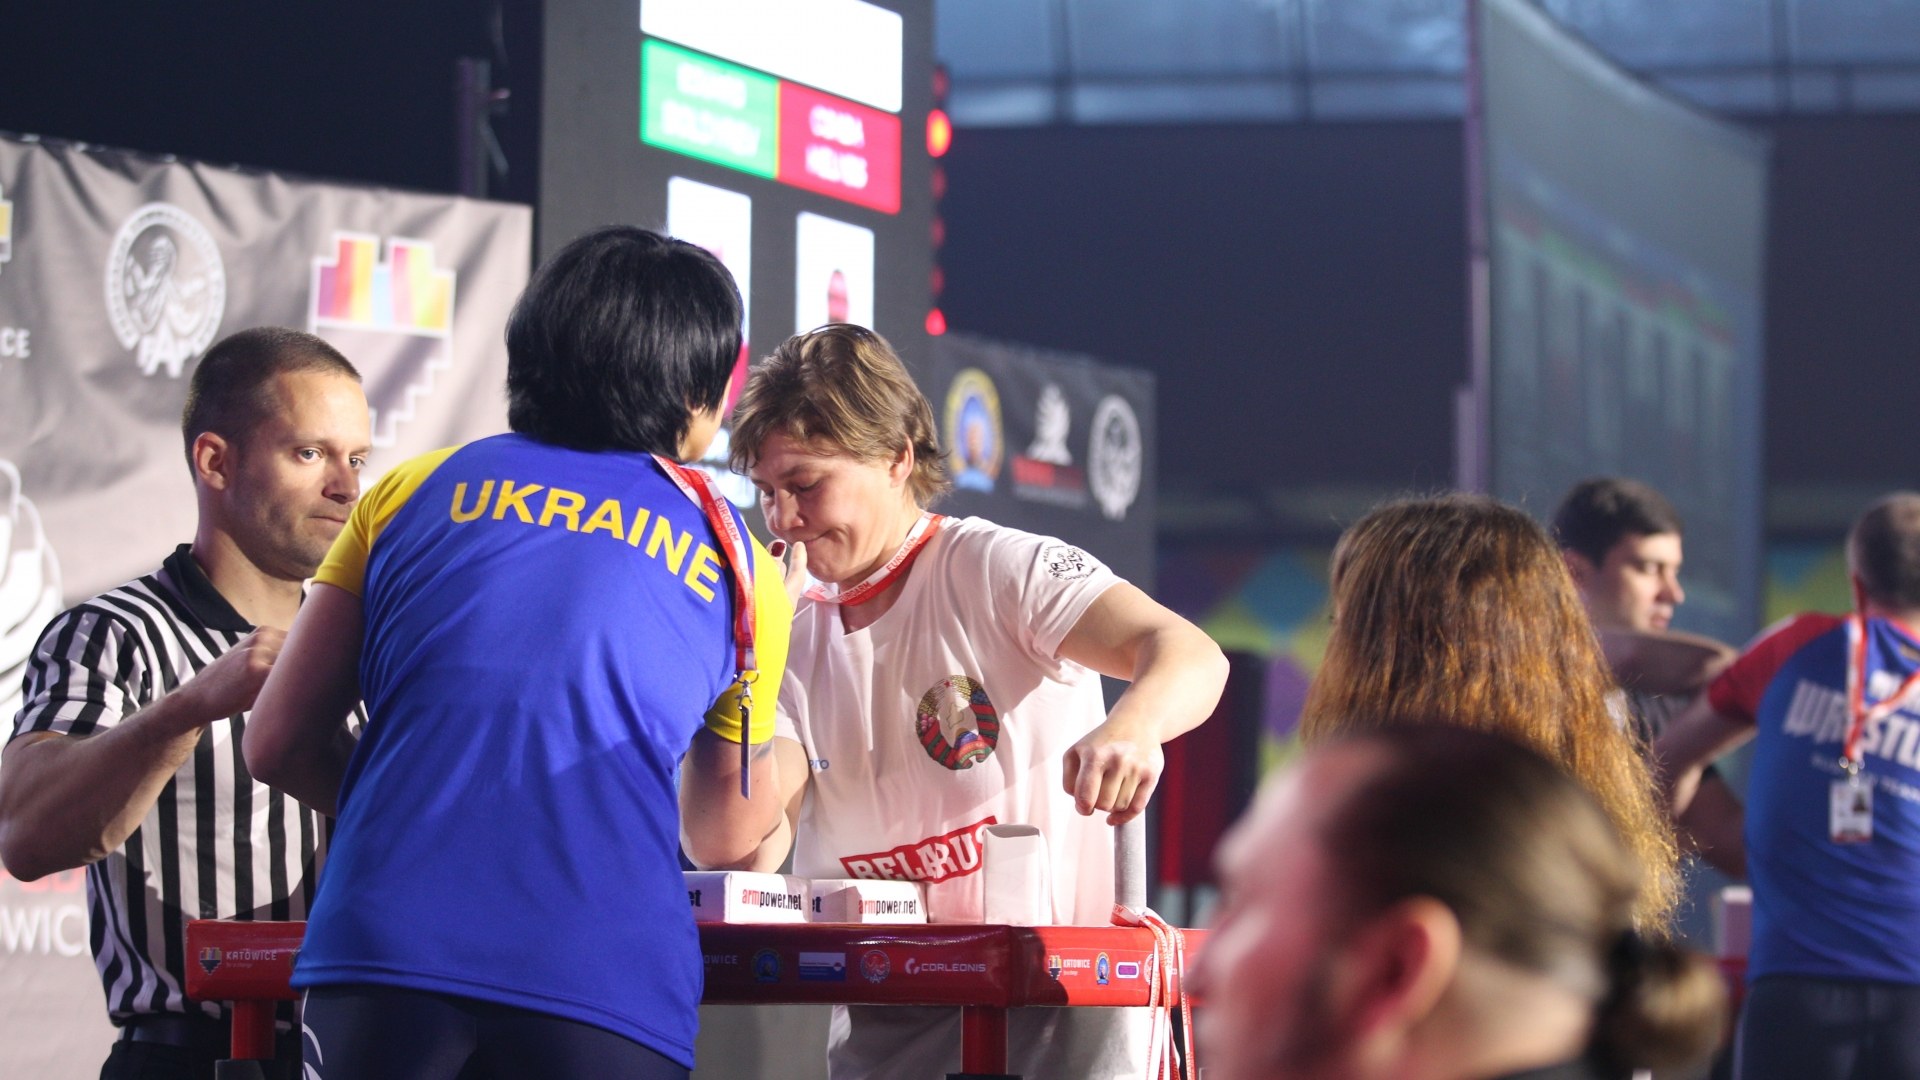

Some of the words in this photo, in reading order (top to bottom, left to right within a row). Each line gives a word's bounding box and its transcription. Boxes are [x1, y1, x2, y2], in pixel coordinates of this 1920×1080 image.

[714, 497, 741, 541] EUROARM
[450, 480, 722, 603] UKRAINE
[885, 535, 918, 572] EUROARM
[741, 888, 802, 911] armpower.net
[858, 898, 917, 916] armpower.net
[225, 950, 277, 961] KATOWICE
[921, 963, 987, 972] CORLEONIS
